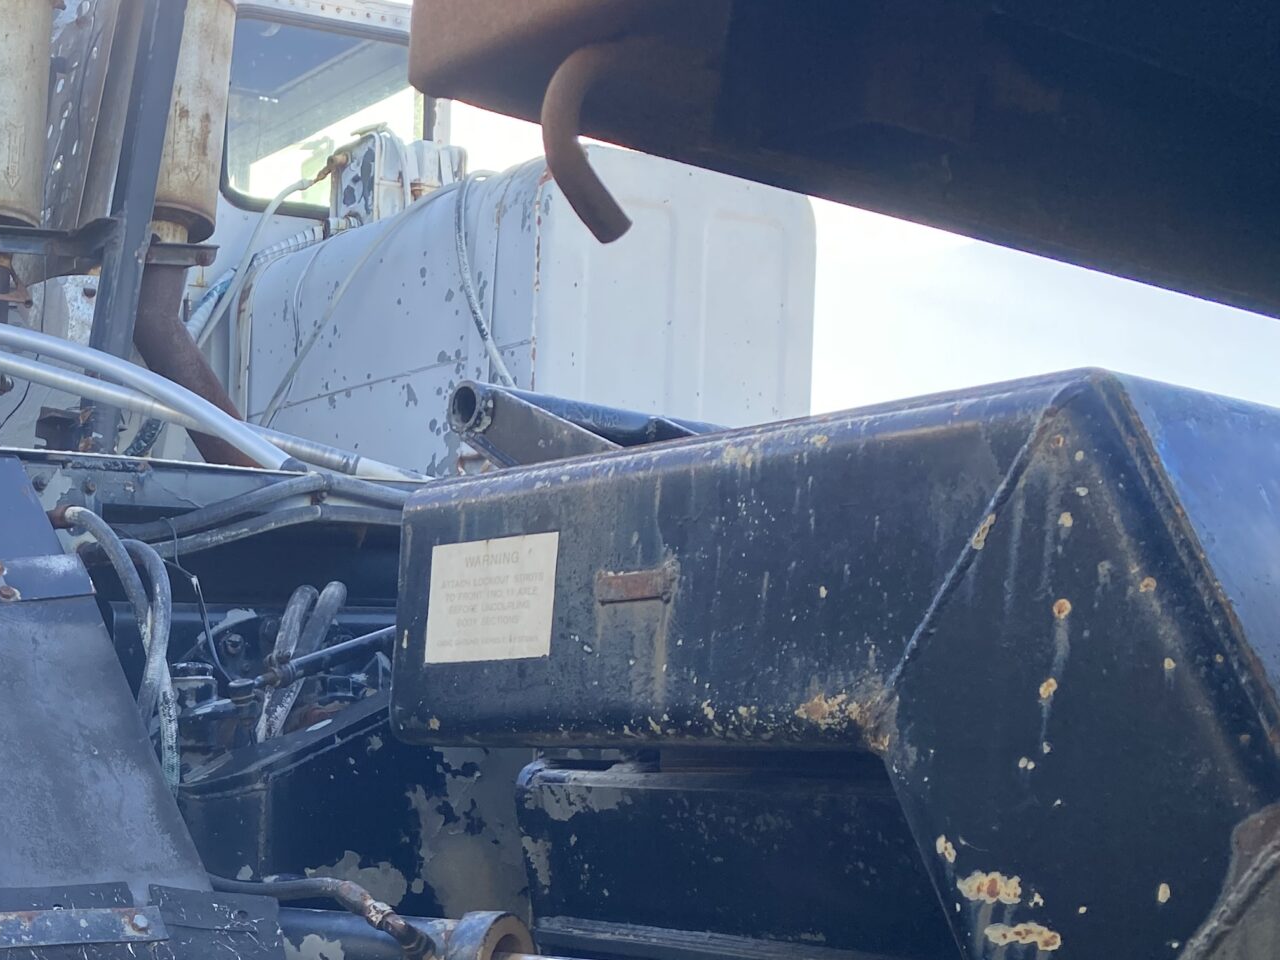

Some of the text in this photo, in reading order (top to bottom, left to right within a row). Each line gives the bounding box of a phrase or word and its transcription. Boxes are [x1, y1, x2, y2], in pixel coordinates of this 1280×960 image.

[465, 551, 520, 568] WARNING
[441, 578, 471, 589] ATTACH
[473, 575, 510, 587] LOCKOUT
[445, 592, 456, 603] TO
[458, 590, 482, 602] FRONT
[448, 600, 530, 615] BEFORE UNCOUPLING
[480, 614, 520, 627] SECTIONS
